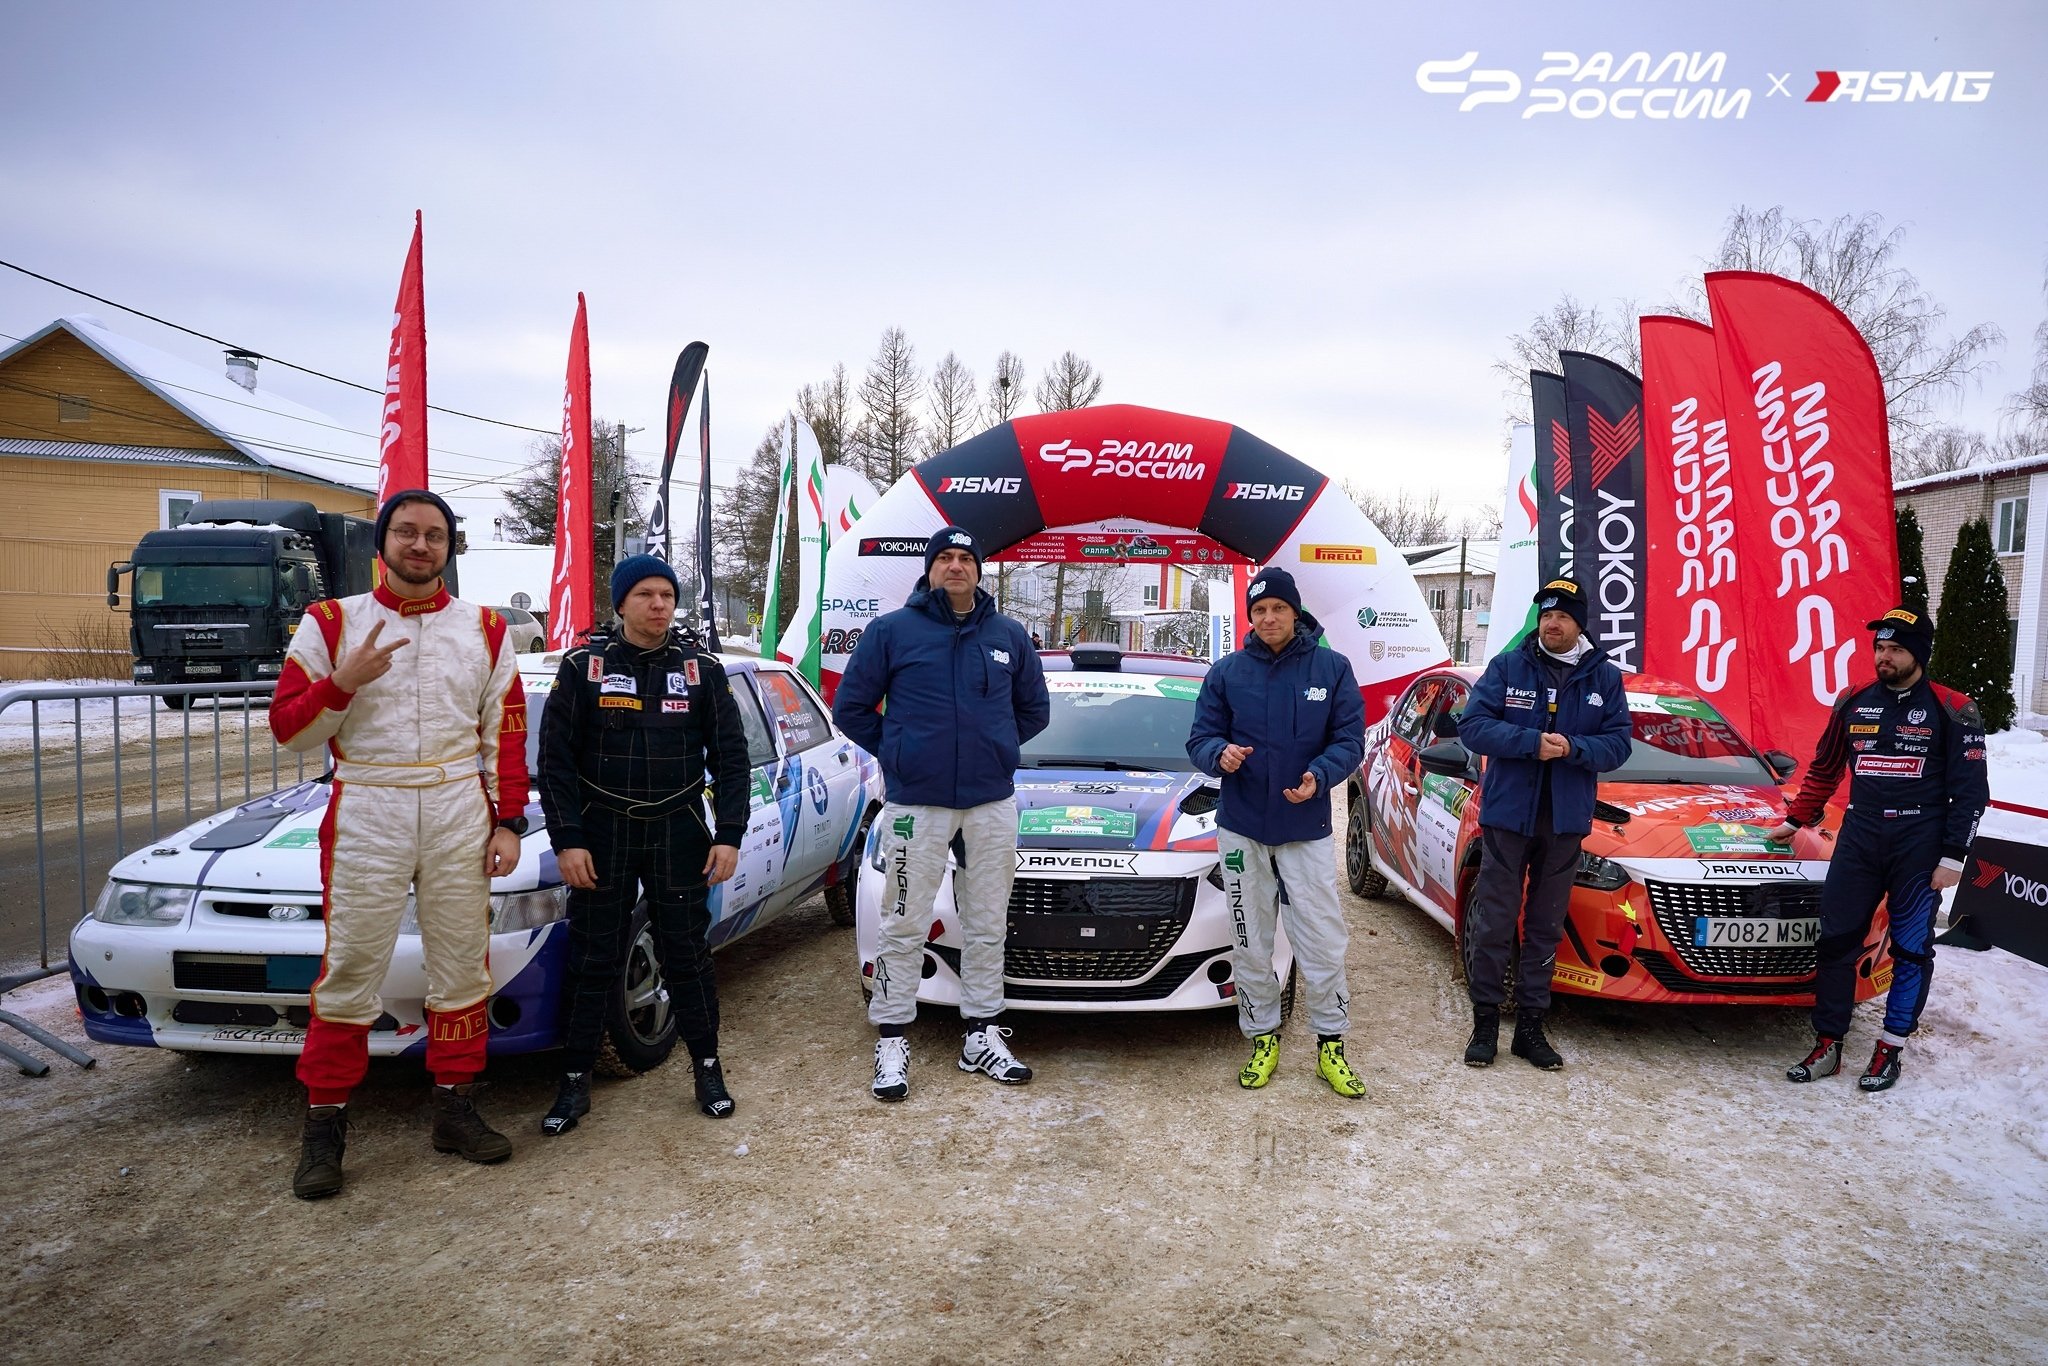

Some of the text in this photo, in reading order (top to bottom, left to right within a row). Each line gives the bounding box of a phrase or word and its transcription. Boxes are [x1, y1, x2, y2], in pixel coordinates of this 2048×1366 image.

[1098, 439, 1194, 460] РАЛЛИ
[1091, 459, 1206, 481] РОССИИ
[945, 477, 1022, 494] ASMG
[1230, 482, 1305, 502] ASMG
[1133, 547, 1168, 555] СУВОРОВ
[1315, 547, 1362, 561] PIRELLI
[404, 601, 437, 613] momo
[821, 598, 880, 612] SPACE
[185, 632, 219, 640] MAN
[1387, 645, 1431, 653] КОРПОРАЦИЯ
[1054, 681, 1147, 691] ТАТНЕФТЬ
[1515, 688, 1537, 698] ИРЗ
[1904, 744, 1929, 753] ИРЗ
[1860, 760, 1916, 769] ROGOZIN
[1028, 856, 1125, 869] RAVENOL
[1712, 865, 1795, 875] RAVENOL
[895, 846, 908, 917] TINGER
[2004, 871, 2048, 907] YOKO
[1230, 878, 1249, 949] TINGER
[1712, 921, 1816, 943] 7082 MSM
